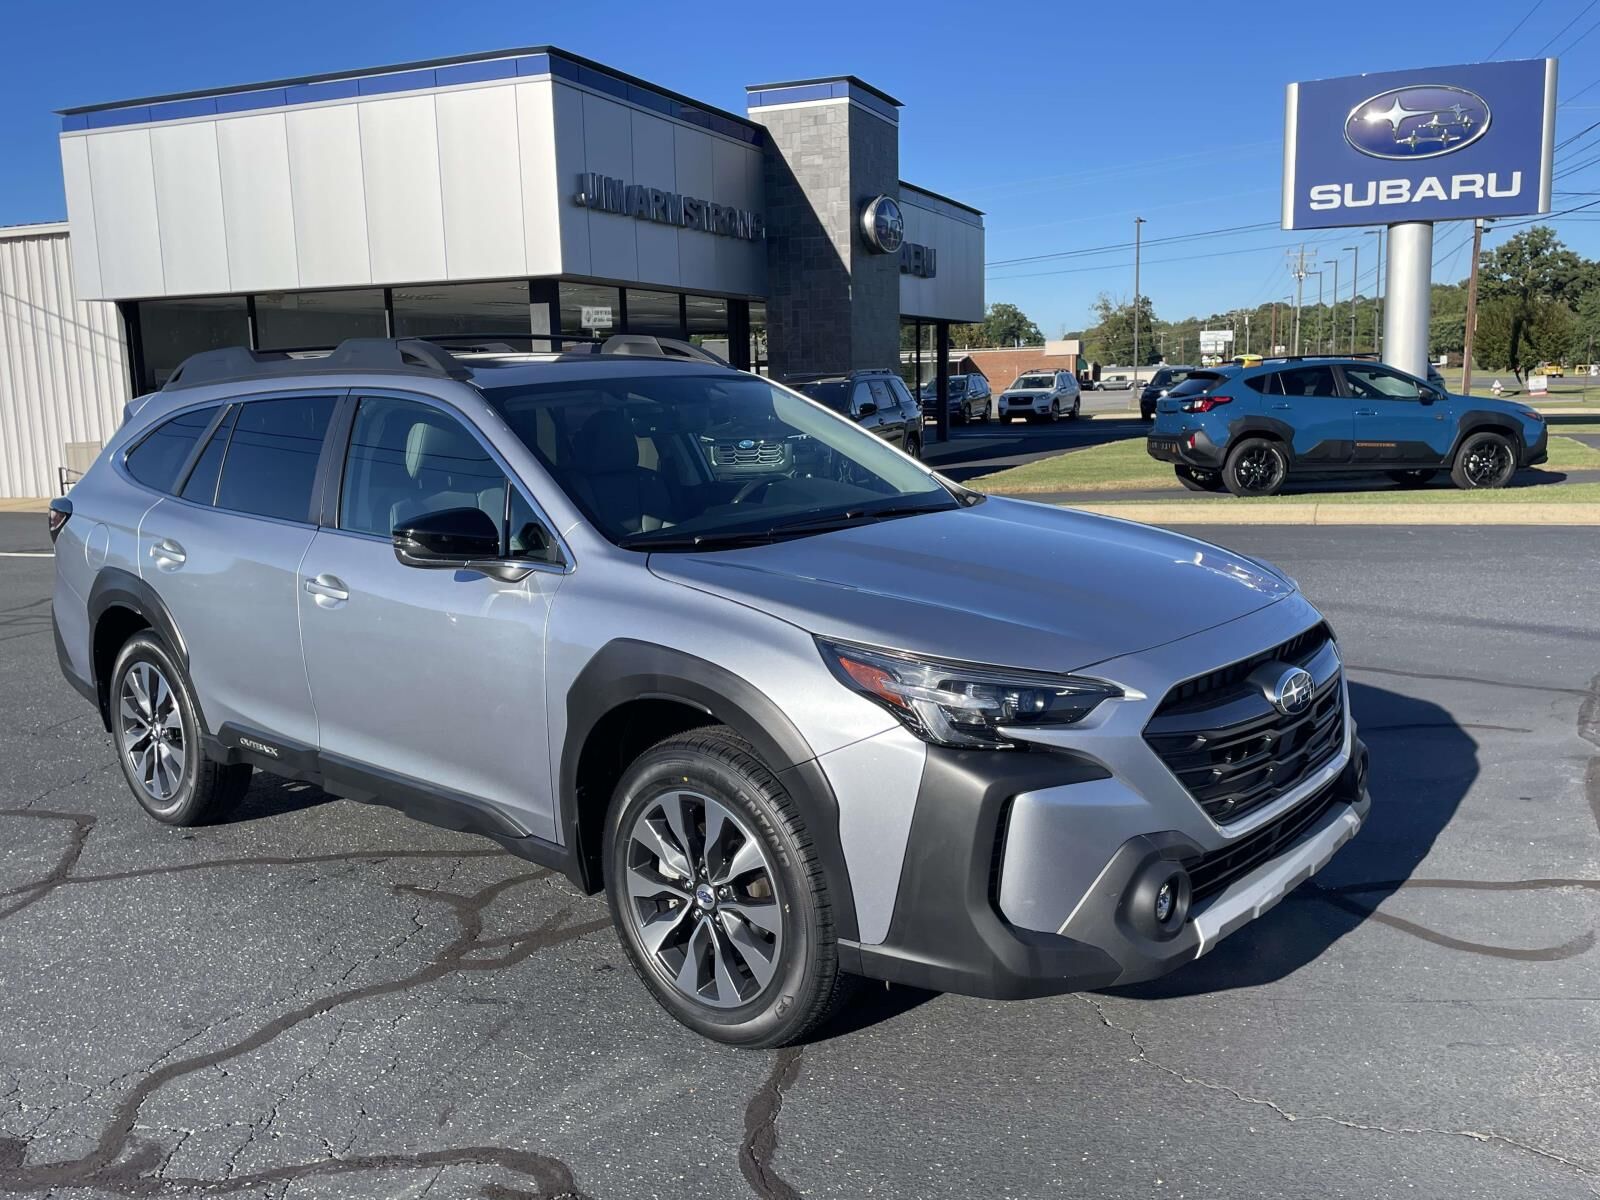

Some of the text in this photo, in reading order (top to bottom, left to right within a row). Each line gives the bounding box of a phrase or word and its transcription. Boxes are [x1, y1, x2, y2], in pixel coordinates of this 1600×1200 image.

[572, 171, 766, 241] JIM ARMSTRONG
[1309, 171, 1522, 211] SUBARU
[240, 737, 278, 757] OUTBACK
